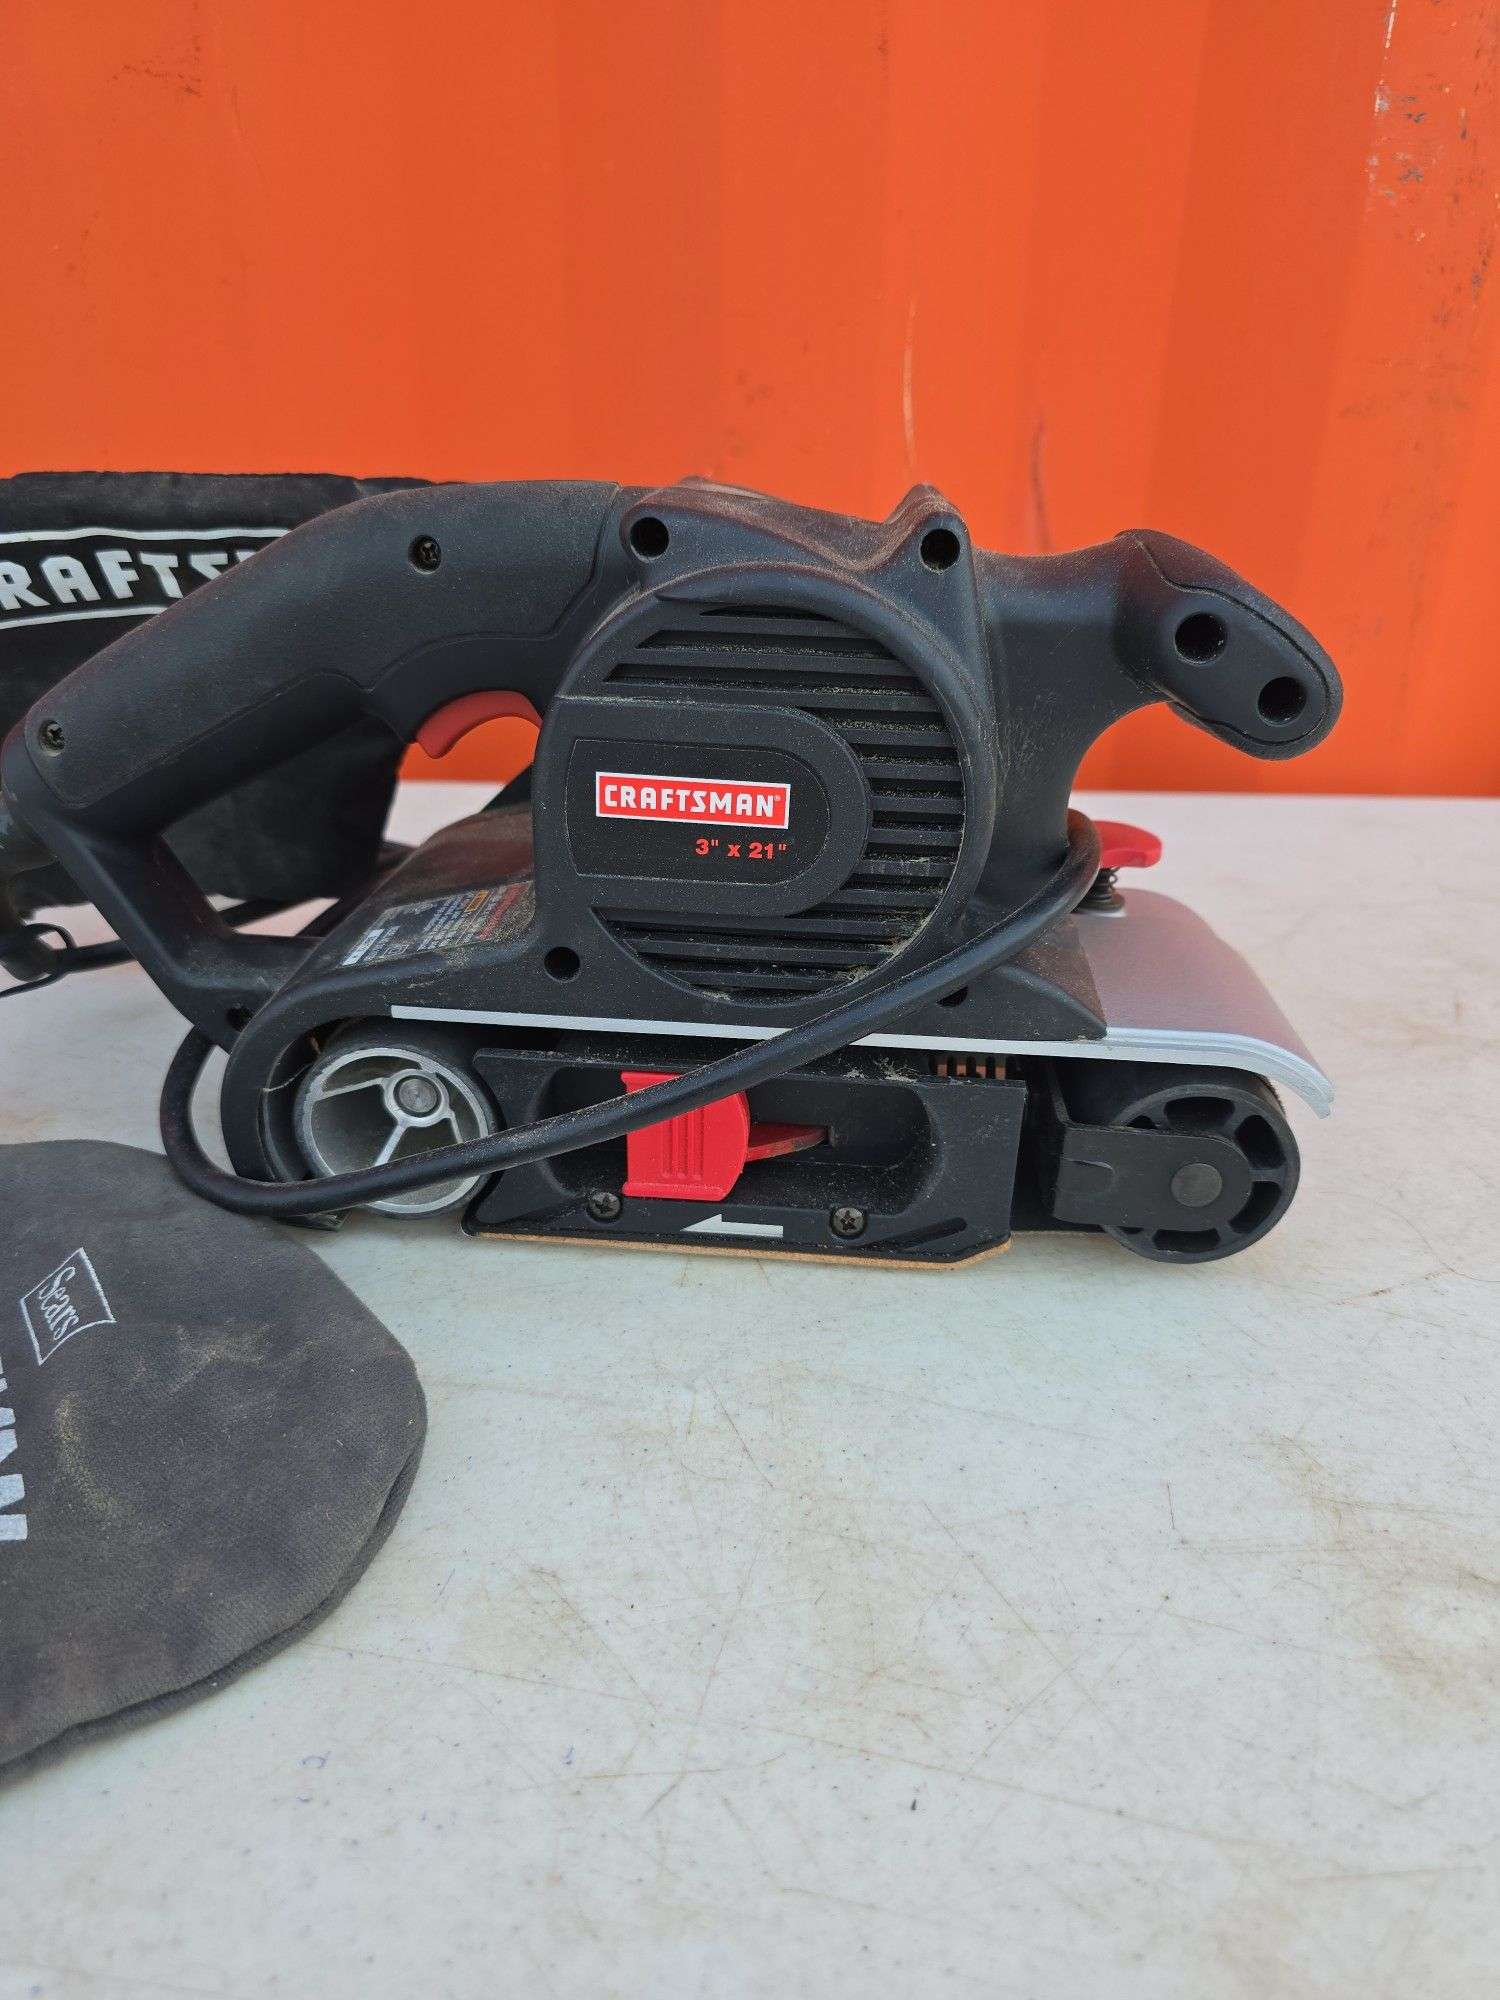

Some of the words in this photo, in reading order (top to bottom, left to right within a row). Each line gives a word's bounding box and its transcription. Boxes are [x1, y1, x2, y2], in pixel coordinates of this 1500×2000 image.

[0, 550, 257, 611] RAFT
[604, 784, 774, 818] CRAFTSMAN
[695, 838, 719, 856] 3"
[727, 842, 741, 859] x
[748, 842, 788, 860] 21"
[38, 1266, 80, 1341] Sears
